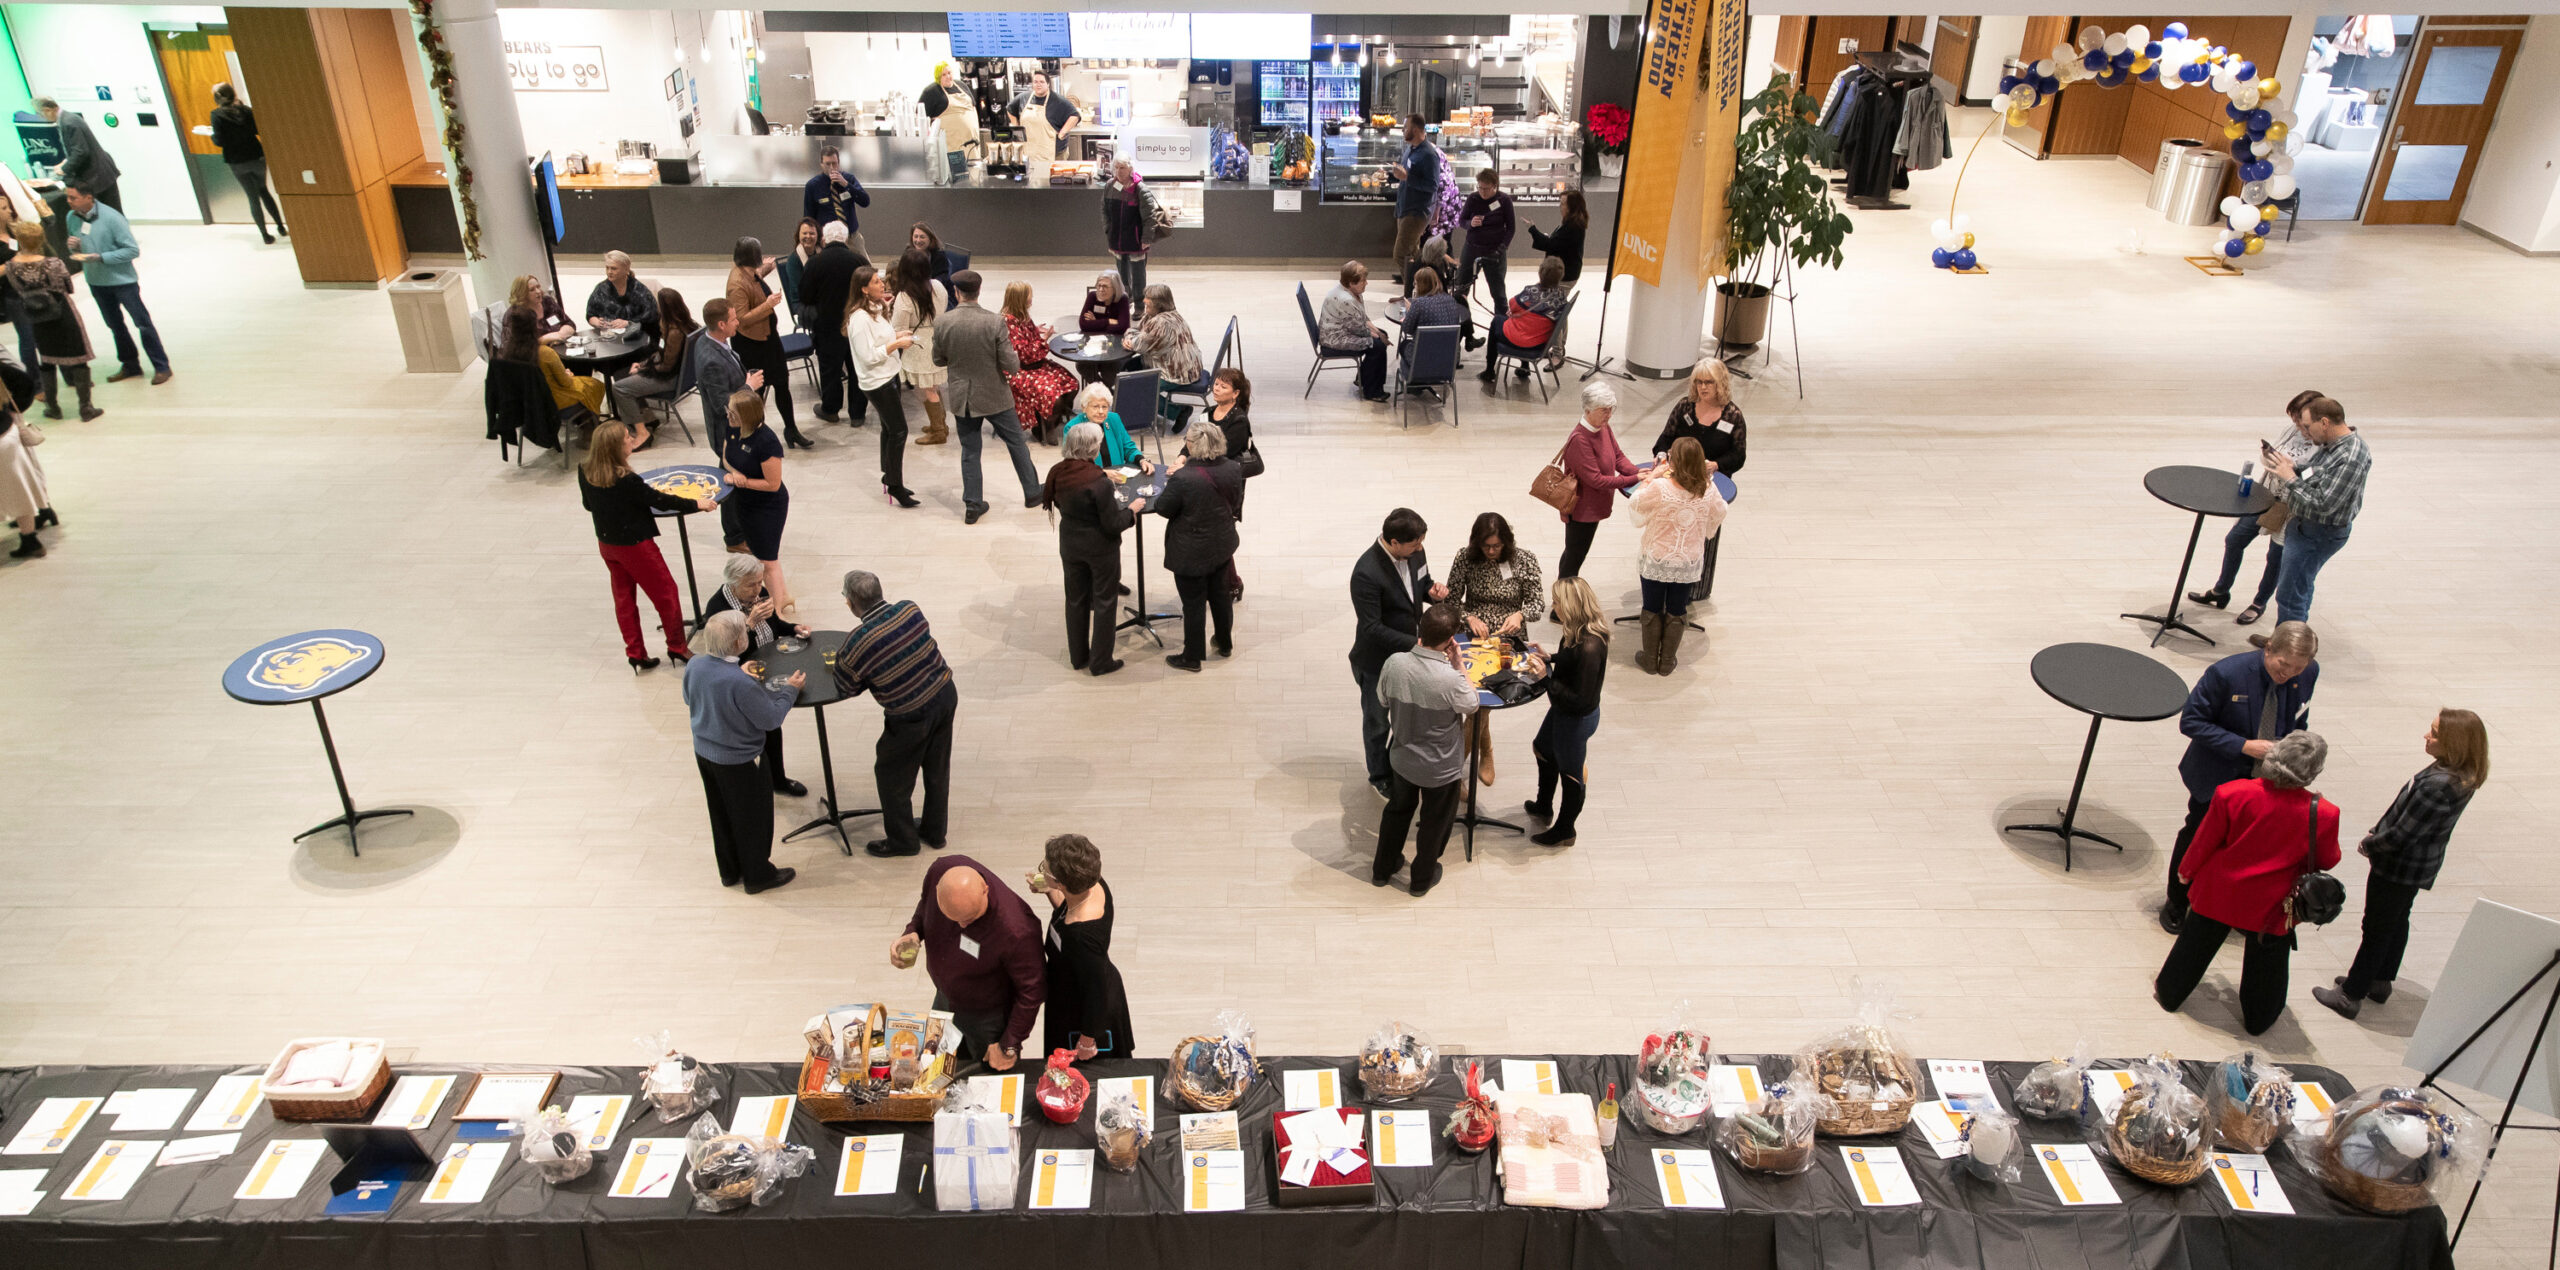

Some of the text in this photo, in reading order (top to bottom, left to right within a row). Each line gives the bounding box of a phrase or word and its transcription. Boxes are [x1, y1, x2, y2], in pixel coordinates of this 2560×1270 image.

[1660, 0, 1688, 100] THERN
[546, 60, 565, 78] to
[573, 64, 600, 87] go
[1678, 64, 1685, 82] OF
[1137, 144, 1190, 155] simply to go
[1623, 232, 1657, 262] UNC
